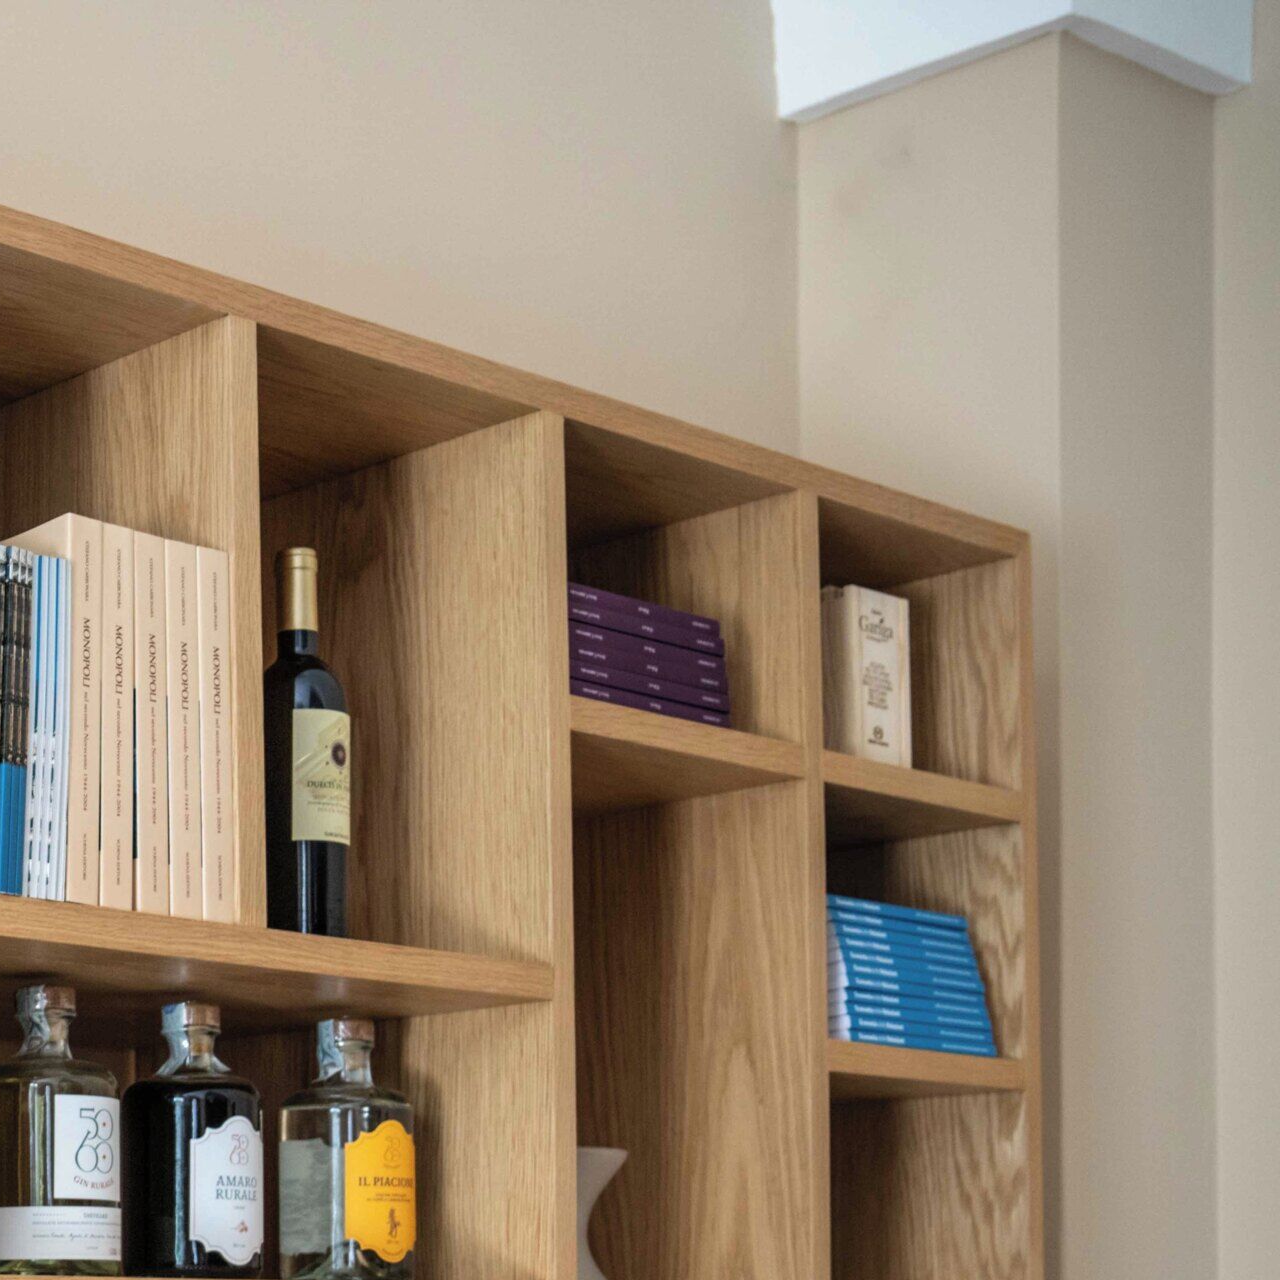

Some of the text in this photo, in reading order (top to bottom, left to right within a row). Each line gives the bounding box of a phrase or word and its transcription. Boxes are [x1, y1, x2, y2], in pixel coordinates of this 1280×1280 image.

[82, 617, 91, 688] MONOPOLI
[115, 624, 123, 695] MONOPOLI
[149, 633, 158, 704] MONOPOLI
[181, 641, 189, 711] MONOPOLI
[213, 646, 221, 715] MONOPOLI
[73, 1175, 88, 1188] GIN
[215, 1189, 257, 1201] RURALE
[216, 1175, 257, 1187] AMARO
[358, 1177, 369, 1186] IL
